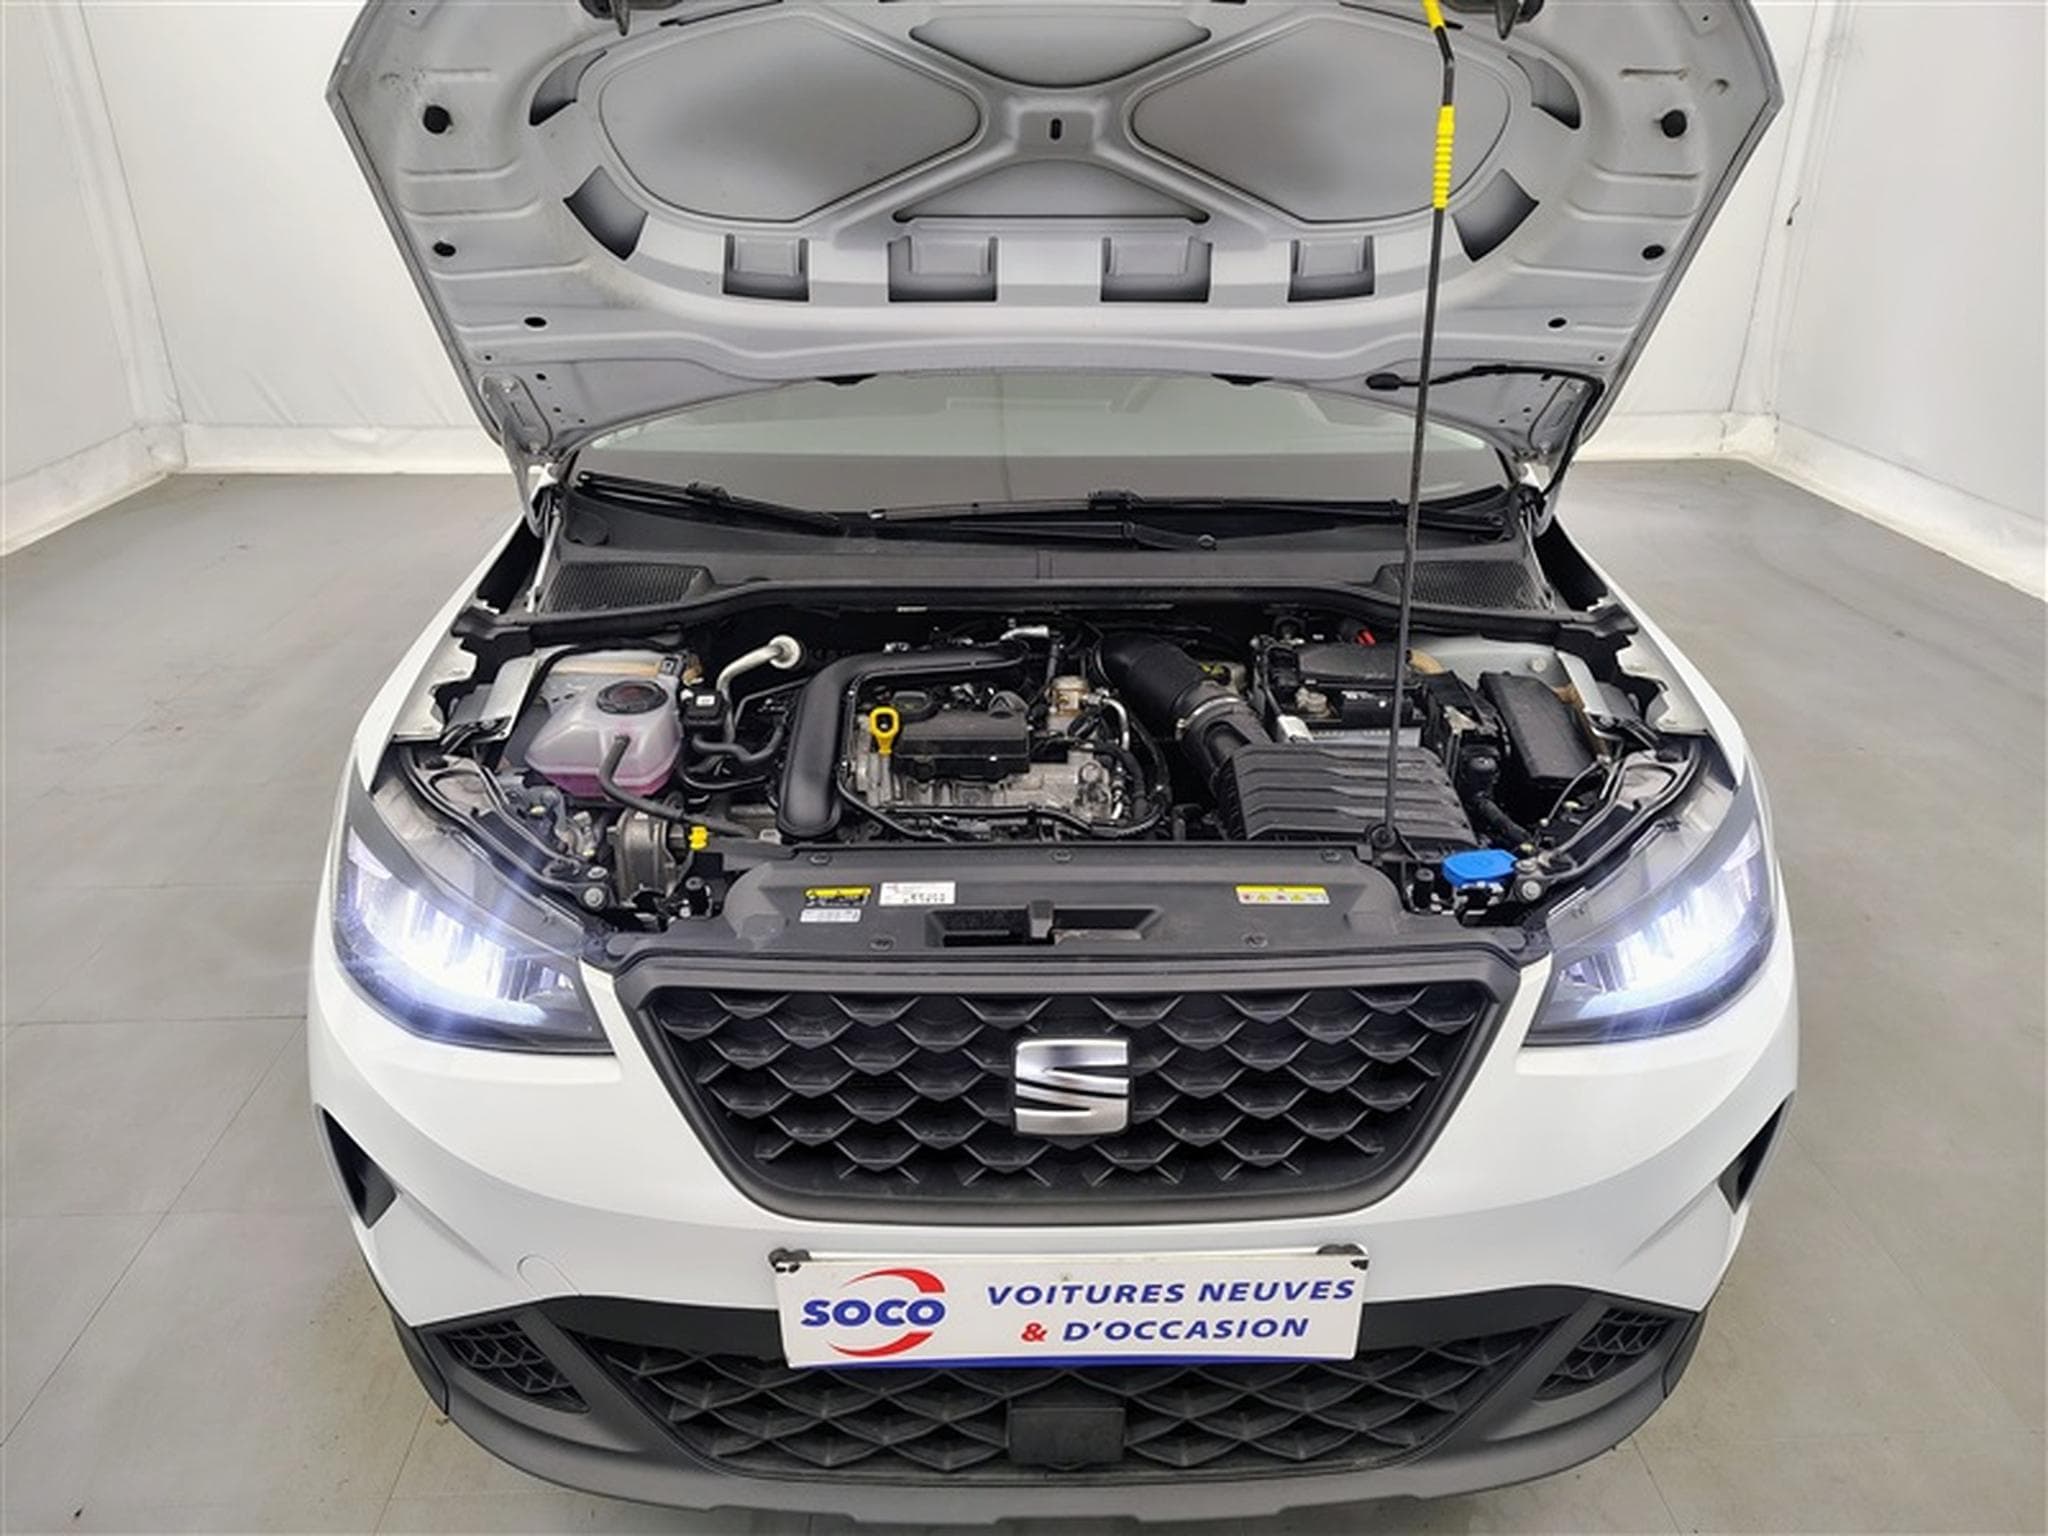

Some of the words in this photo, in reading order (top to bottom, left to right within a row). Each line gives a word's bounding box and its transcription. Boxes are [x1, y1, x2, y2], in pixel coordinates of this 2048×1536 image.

[987, 1283, 1185, 1306] VOITURES
[1199, 1279, 1355, 1302] NEUVES
[801, 1299, 945, 1328] SOCO
[1021, 1322, 1048, 1342] &
[1063, 1318, 1308, 1342] D'OCCASION
